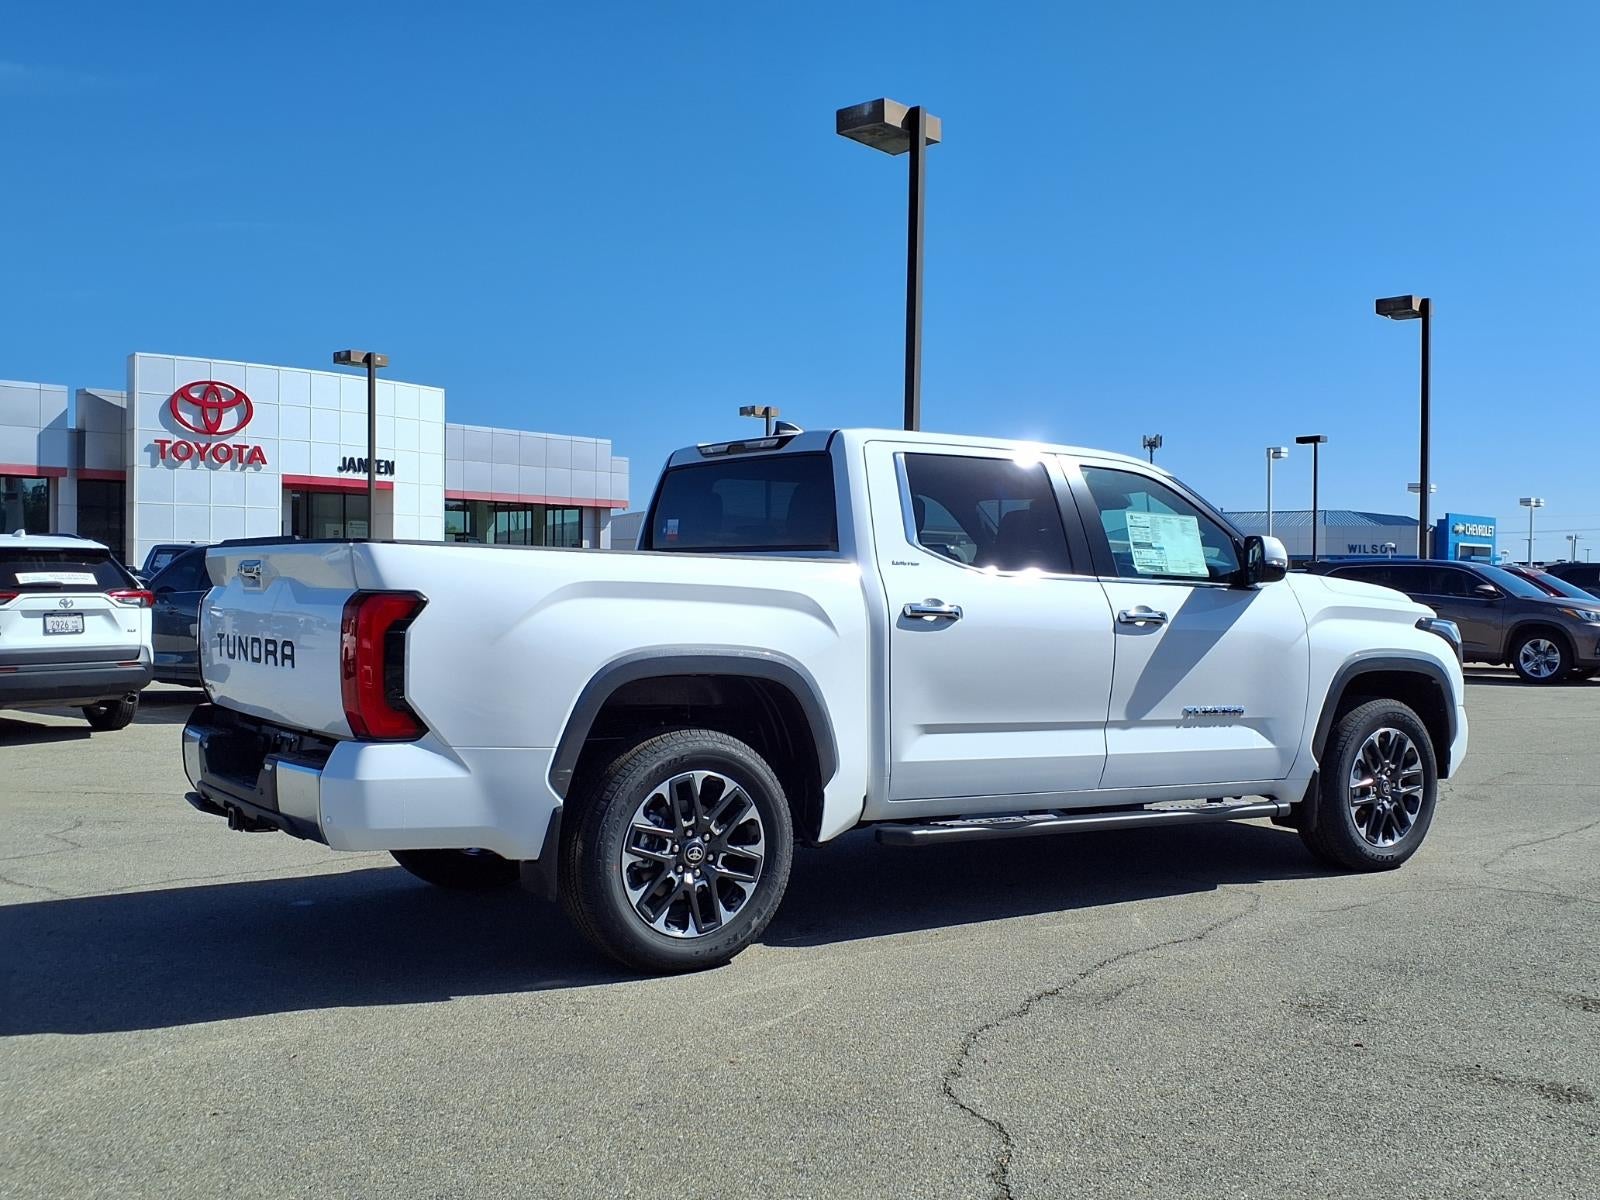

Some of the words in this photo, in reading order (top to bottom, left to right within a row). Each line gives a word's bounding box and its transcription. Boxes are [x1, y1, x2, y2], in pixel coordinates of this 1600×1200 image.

[154, 439, 267, 465] TOYOTA
[337, 456, 395, 476] JANEN
[1465, 523, 1494, 537] CHEVROLET
[217, 632, 295, 669] TUNDRA
